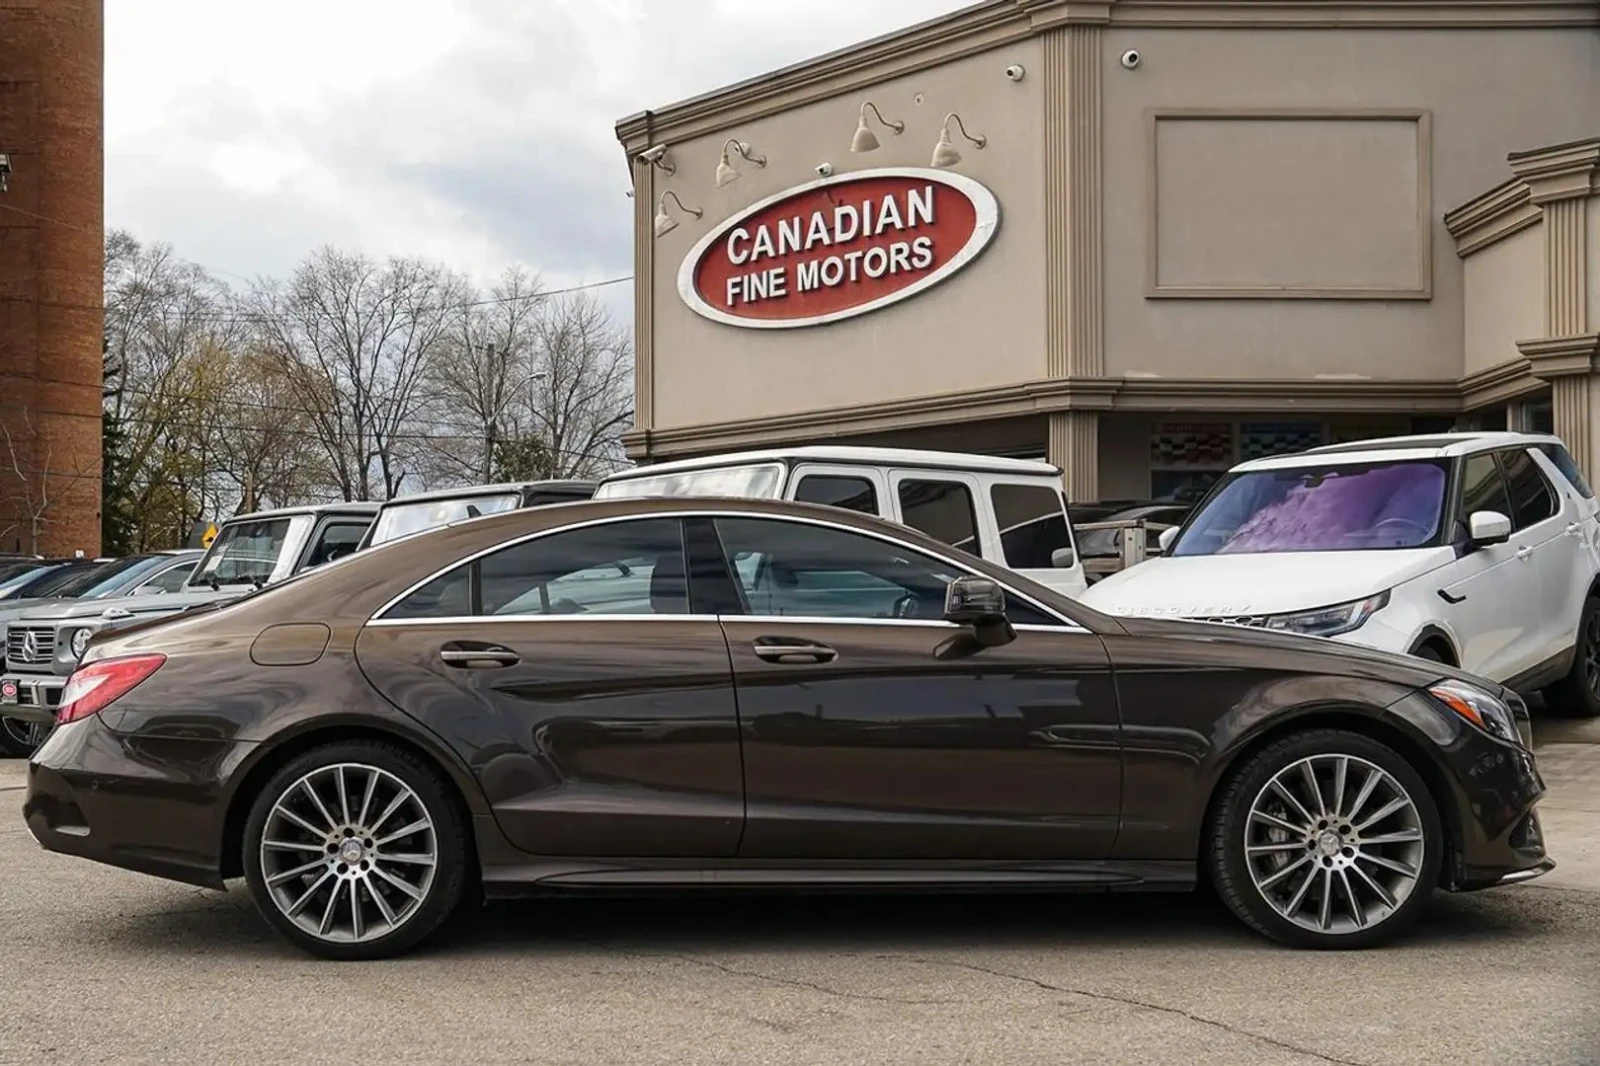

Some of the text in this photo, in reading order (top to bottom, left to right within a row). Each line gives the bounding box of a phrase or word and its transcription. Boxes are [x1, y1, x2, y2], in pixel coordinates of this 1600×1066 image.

[727, 185, 935, 265] CANADIAN
[726, 236, 934, 306] FINE MOTORS
[1113, 603, 1252, 615] DISCOVERY
